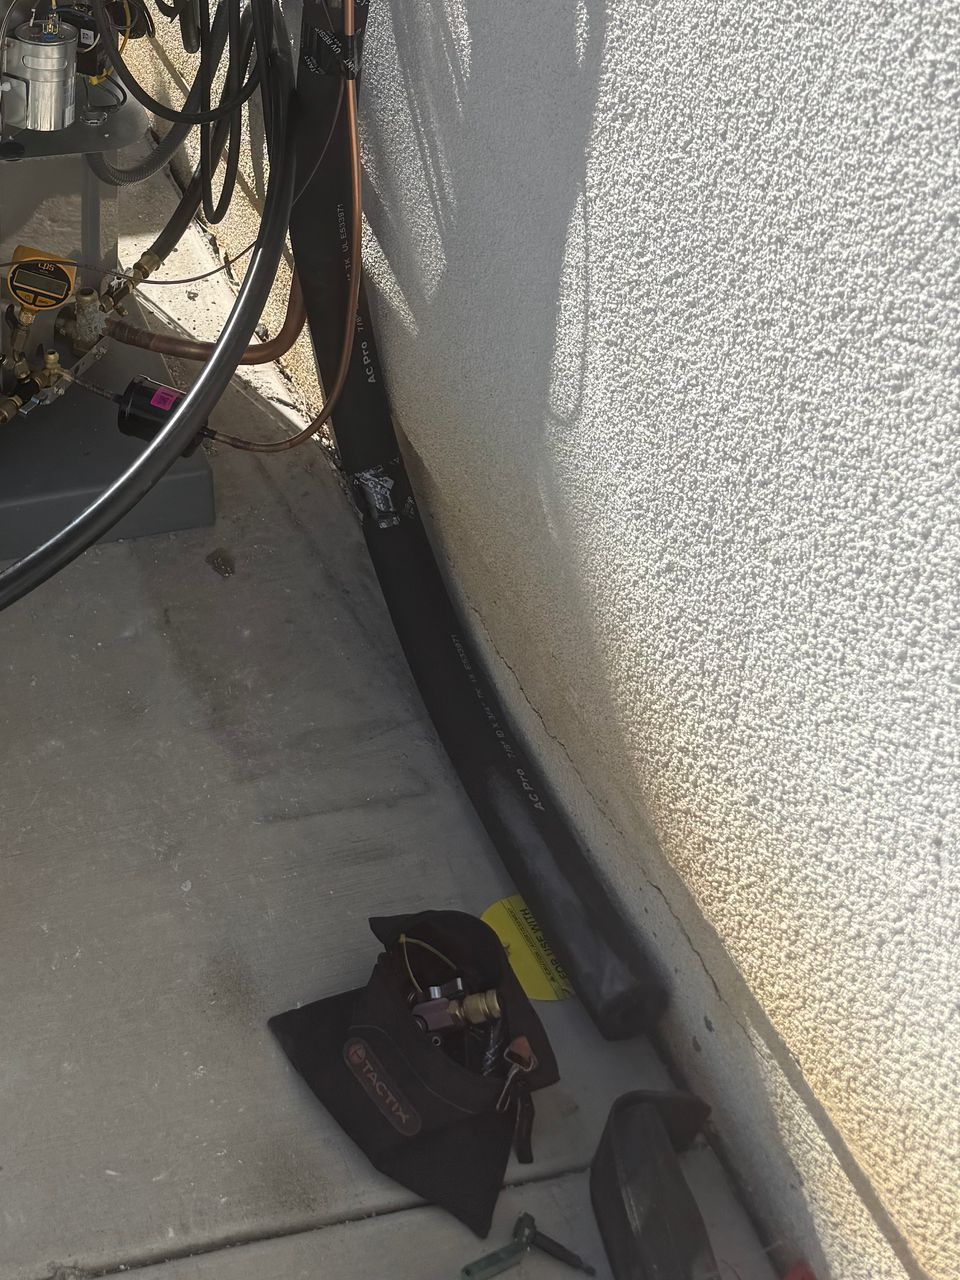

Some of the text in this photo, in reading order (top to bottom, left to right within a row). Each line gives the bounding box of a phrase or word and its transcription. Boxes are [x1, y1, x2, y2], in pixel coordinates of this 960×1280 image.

[341, 242, 349, 253] UL
[361, 341, 371, 365] Pro
[366, 366, 376, 384] AC
[516, 768, 534, 791] Pro
[529, 793, 545, 811] AC
[362, 1059, 410, 1124] TACTIX
